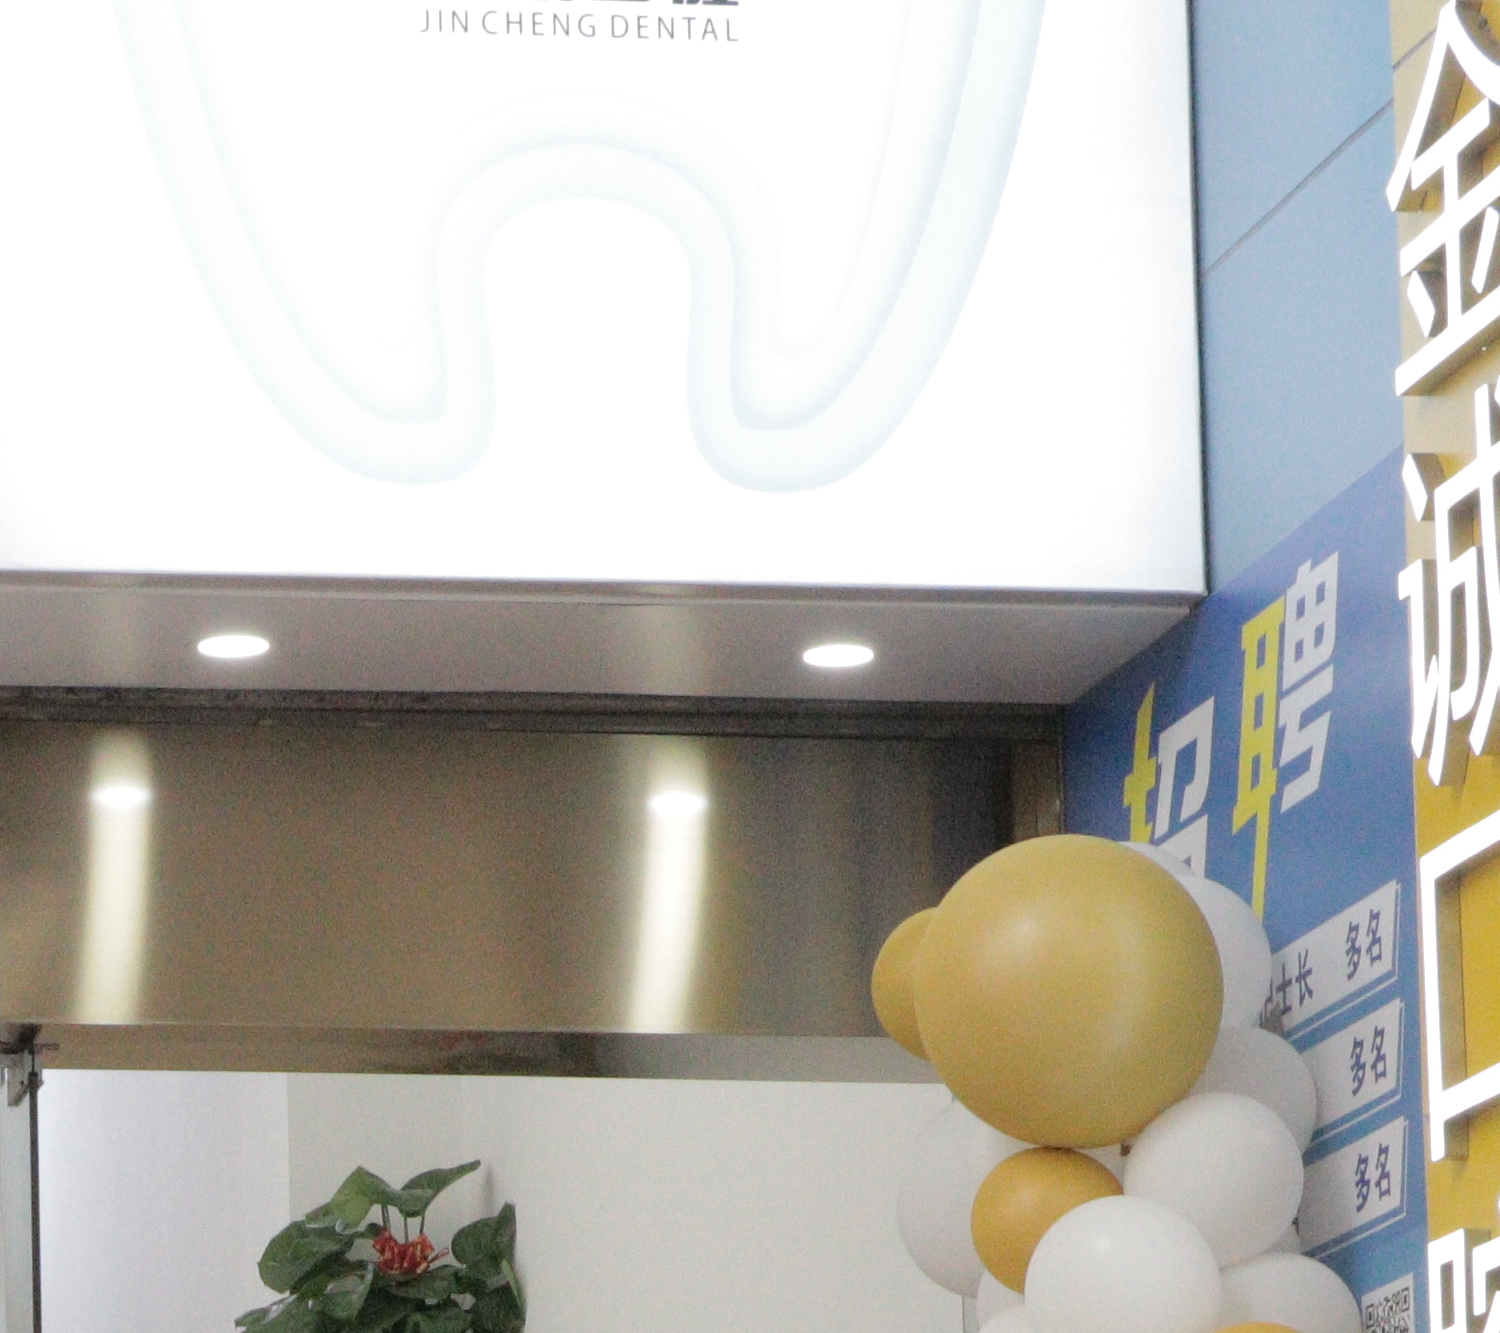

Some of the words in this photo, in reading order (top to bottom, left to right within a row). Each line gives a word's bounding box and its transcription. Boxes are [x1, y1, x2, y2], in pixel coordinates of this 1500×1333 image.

[481, 10, 597, 38] CHENG
[611, 15, 739, 42] DENTAL
[1345, 910, 1382, 980] 多名
[1350, 1026, 1387, 1096] 多名
[1355, 1143, 1391, 1213] 多名
